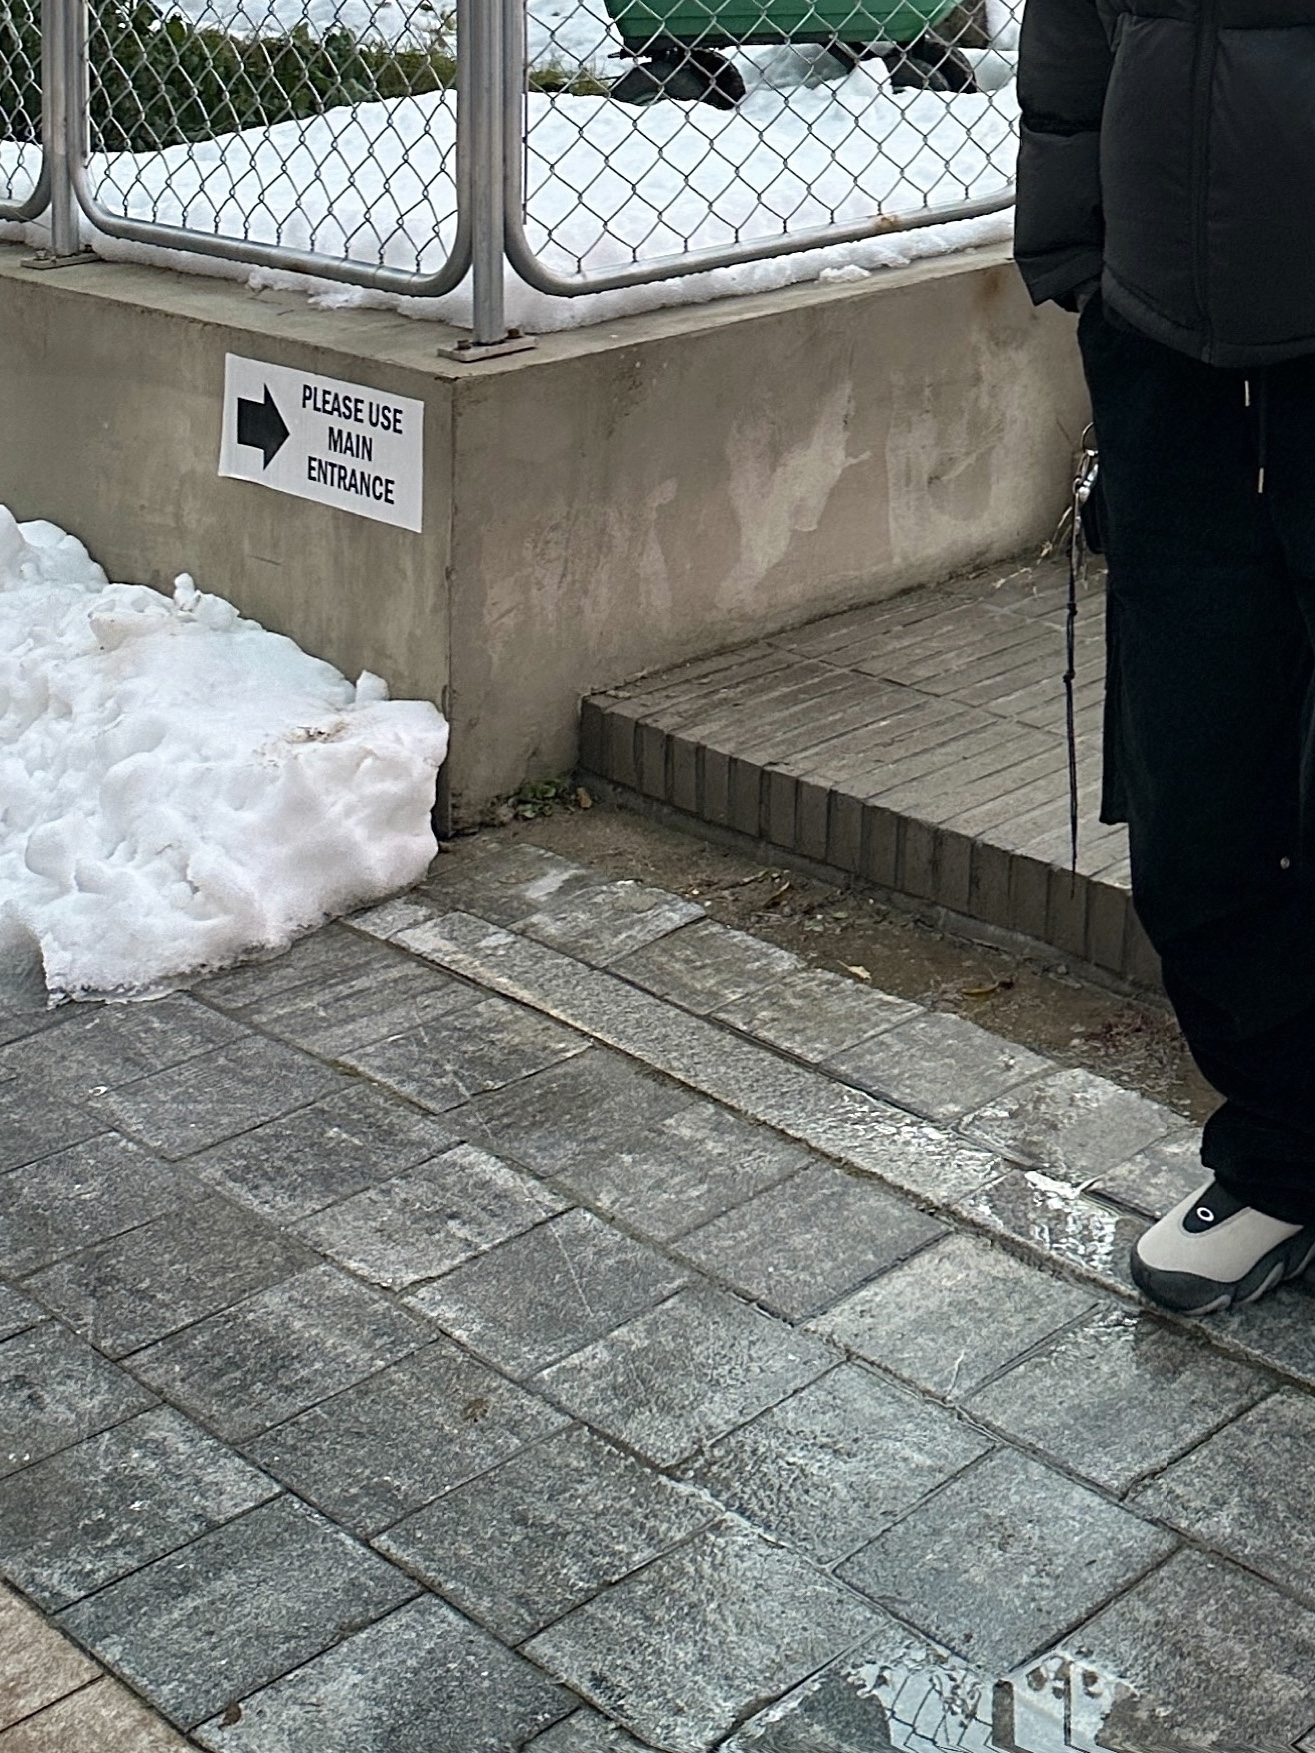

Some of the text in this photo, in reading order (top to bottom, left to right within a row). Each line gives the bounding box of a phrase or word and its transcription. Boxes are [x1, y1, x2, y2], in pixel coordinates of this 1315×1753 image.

[302, 384, 404, 435] PLEASE USE
[328, 426, 373, 463] MAIN
[307, 455, 395, 505] ENTRANCE
